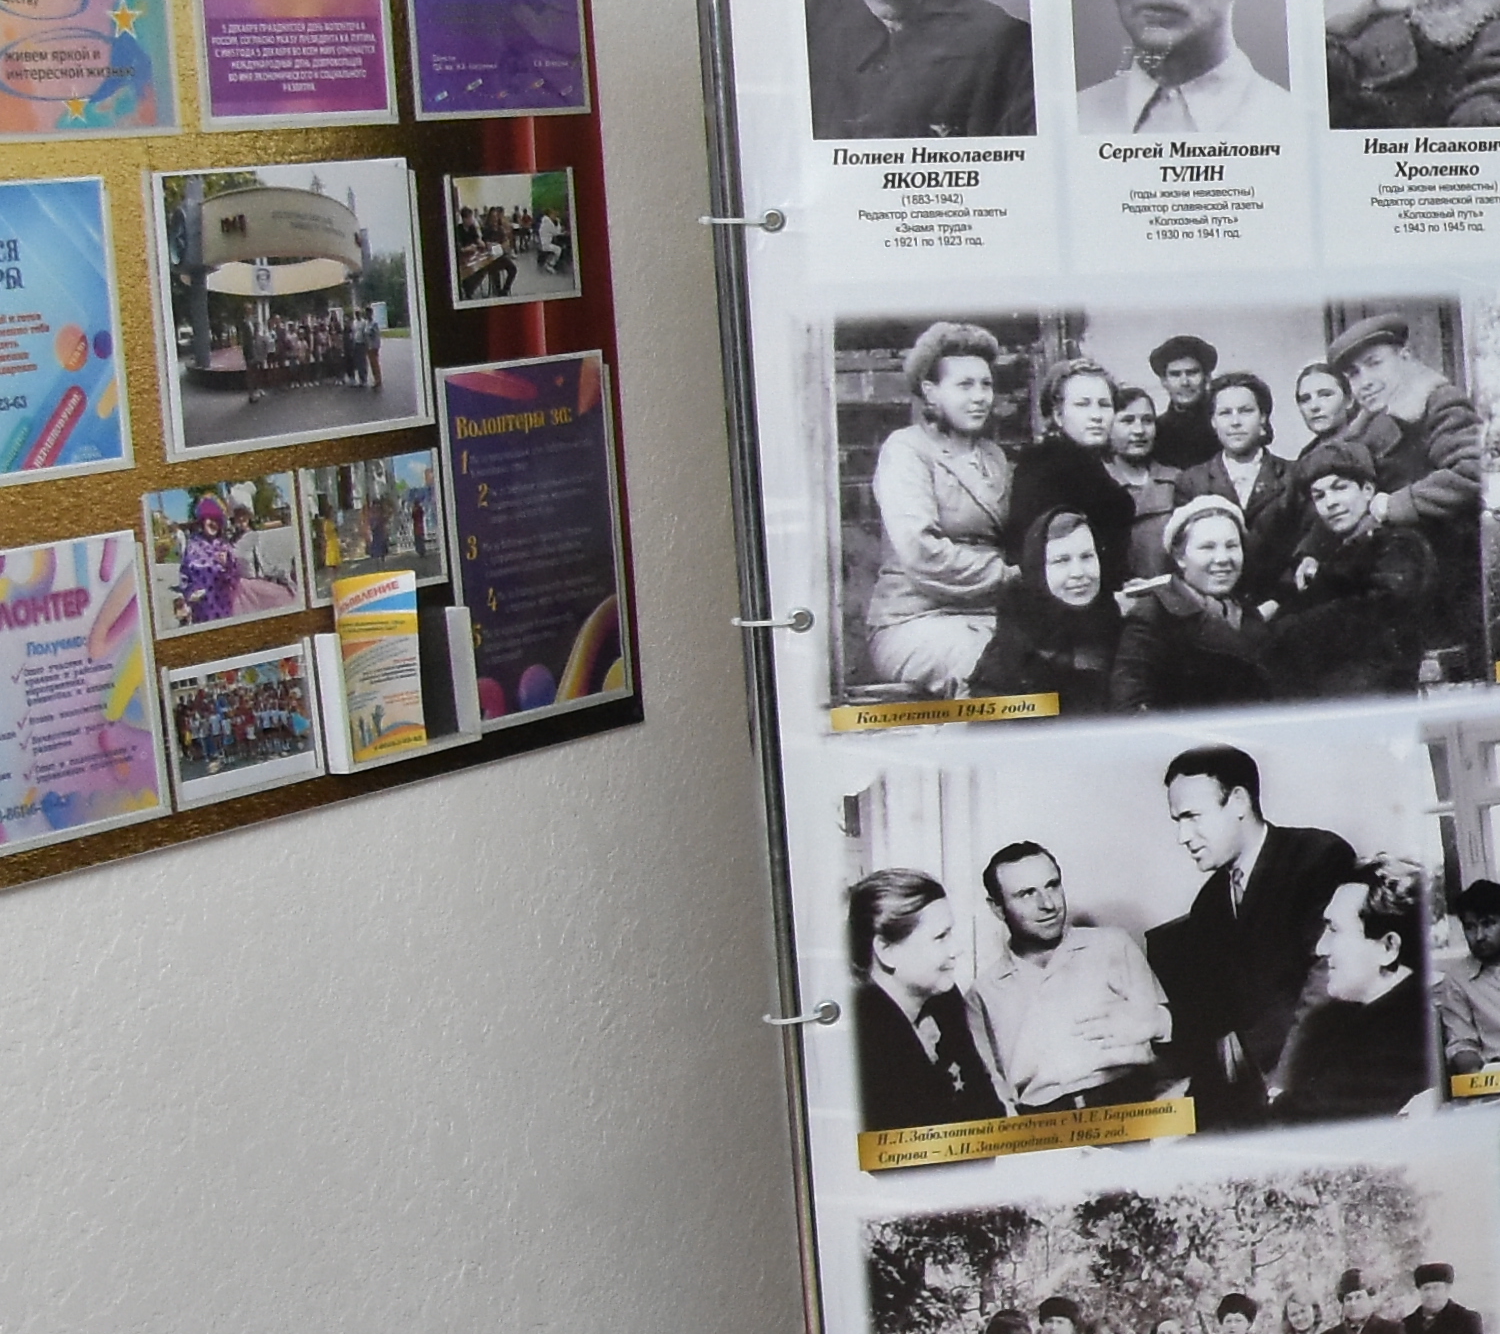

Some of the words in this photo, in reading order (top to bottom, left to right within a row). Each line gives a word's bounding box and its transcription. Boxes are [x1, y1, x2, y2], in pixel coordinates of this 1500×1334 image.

[1098, 142, 1163, 163] Сергей
[1169, 141, 1280, 158] Михайлович
[1363, 137, 1409, 154] Иван
[833, 148, 904, 165] Полиен
[911, 146, 1025, 164] Николаевич
[882, 170, 979, 189] ЯКОВЛЕВ
[1159, 164, 1224, 182] ТУЛИН
[1394, 161, 1479, 181] Хроленко
[858, 209, 908, 222] Редактор
[972, 208, 1007, 217] газеты
[884, 239, 891, 247] с
[893, 236, 918, 247] 1921
[921, 238, 935, 247] по
[937, 235, 962, 246] 1923
[964, 236, 984, 246] год.
[0, 587, 91, 632] ЛОНТЕР
[957, 702, 996, 717] 1945
[1000, 700, 1035, 714] года
